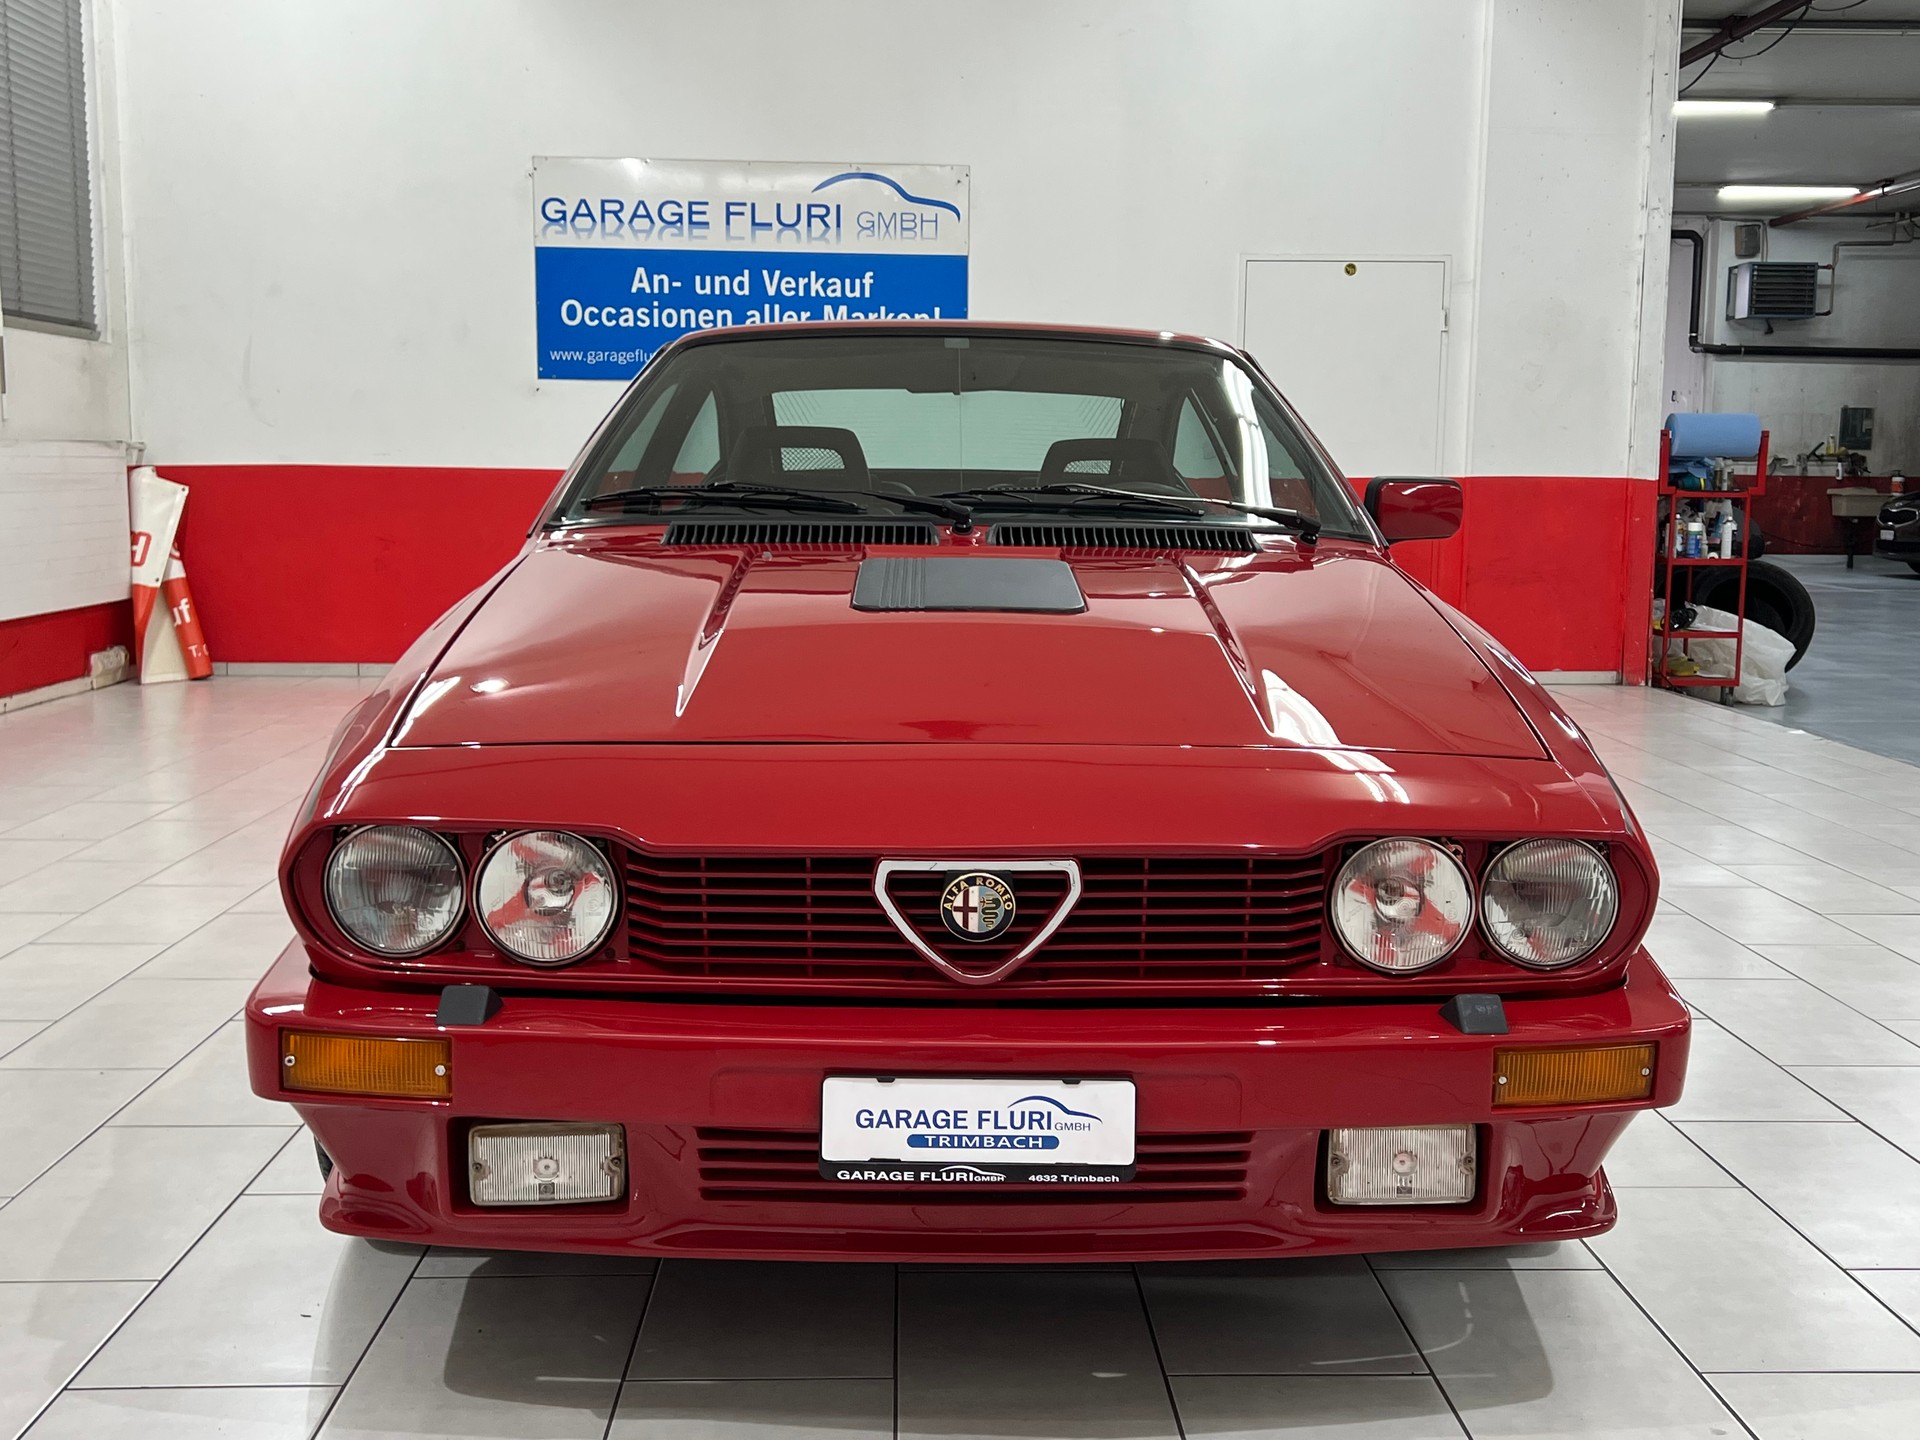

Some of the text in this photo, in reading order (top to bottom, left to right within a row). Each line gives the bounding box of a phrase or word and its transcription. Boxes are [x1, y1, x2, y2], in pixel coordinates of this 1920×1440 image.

[541, 197, 939, 231] GARAGE FLURI GMBH
[631, 266, 874, 298] An- und Verkauf
[560, 299, 733, 329] Occasionen
[745, 303, 812, 325] aller
[943, 877, 1013, 911] ALFA ROMEO
[855, 1109, 1091, 1132] GARAGE FLURI GMBH
[924, 1135, 1044, 1148] TRIMBACH
[837, 1169, 915, 1181] GARAGE
[920, 1170, 973, 1182] FLURI
[1028, 1174, 1057, 1182] 4632
[1060, 1173, 1120, 1183] Trimbach
